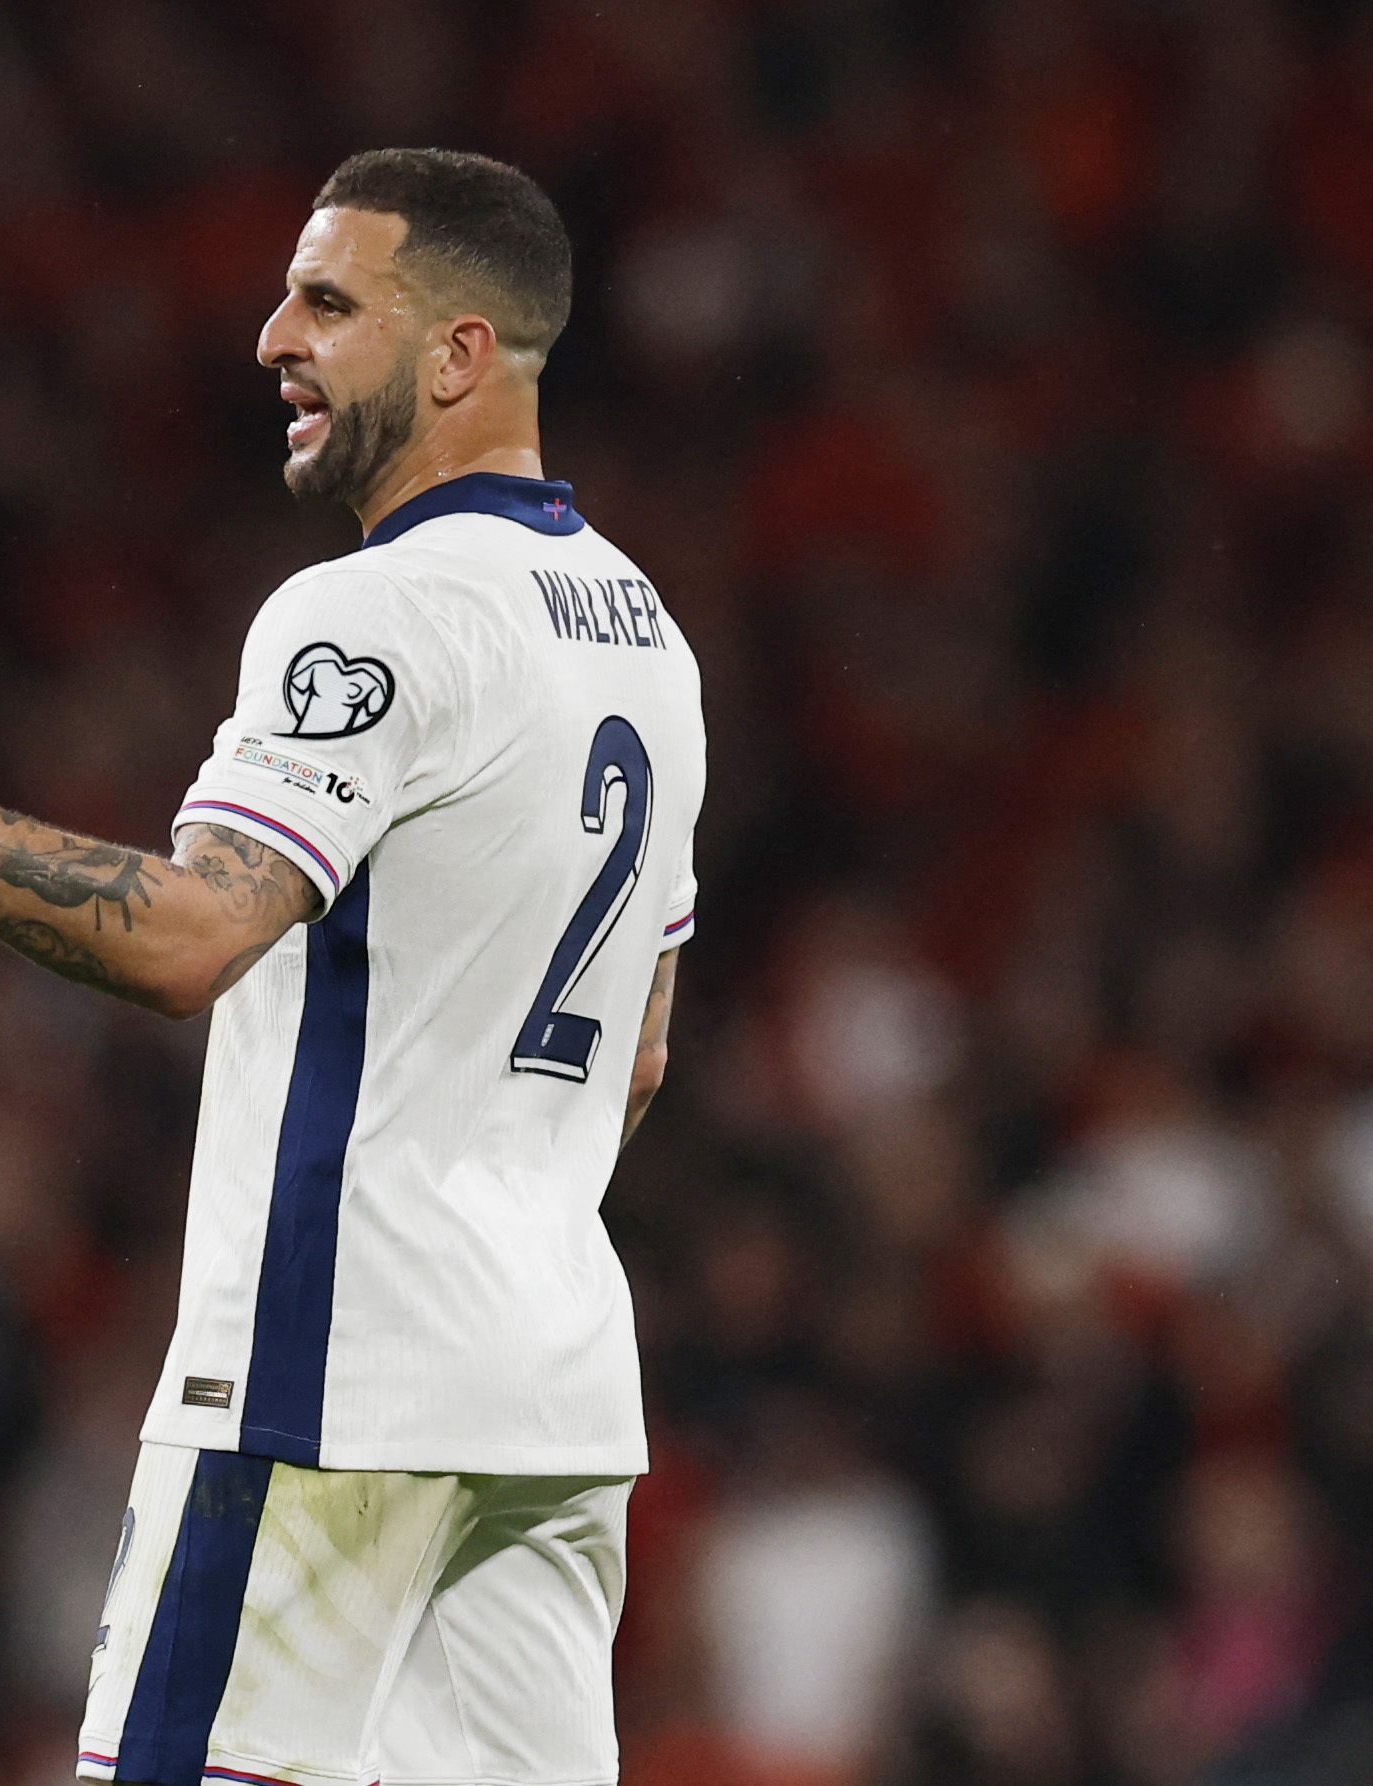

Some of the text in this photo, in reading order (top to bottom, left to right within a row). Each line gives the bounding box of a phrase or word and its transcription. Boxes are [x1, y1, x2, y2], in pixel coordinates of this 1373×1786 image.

[530, 569, 667, 650] WALKER
[234, 747, 323, 783] FOUNDATION
[509, 713, 654, 1084] 2
